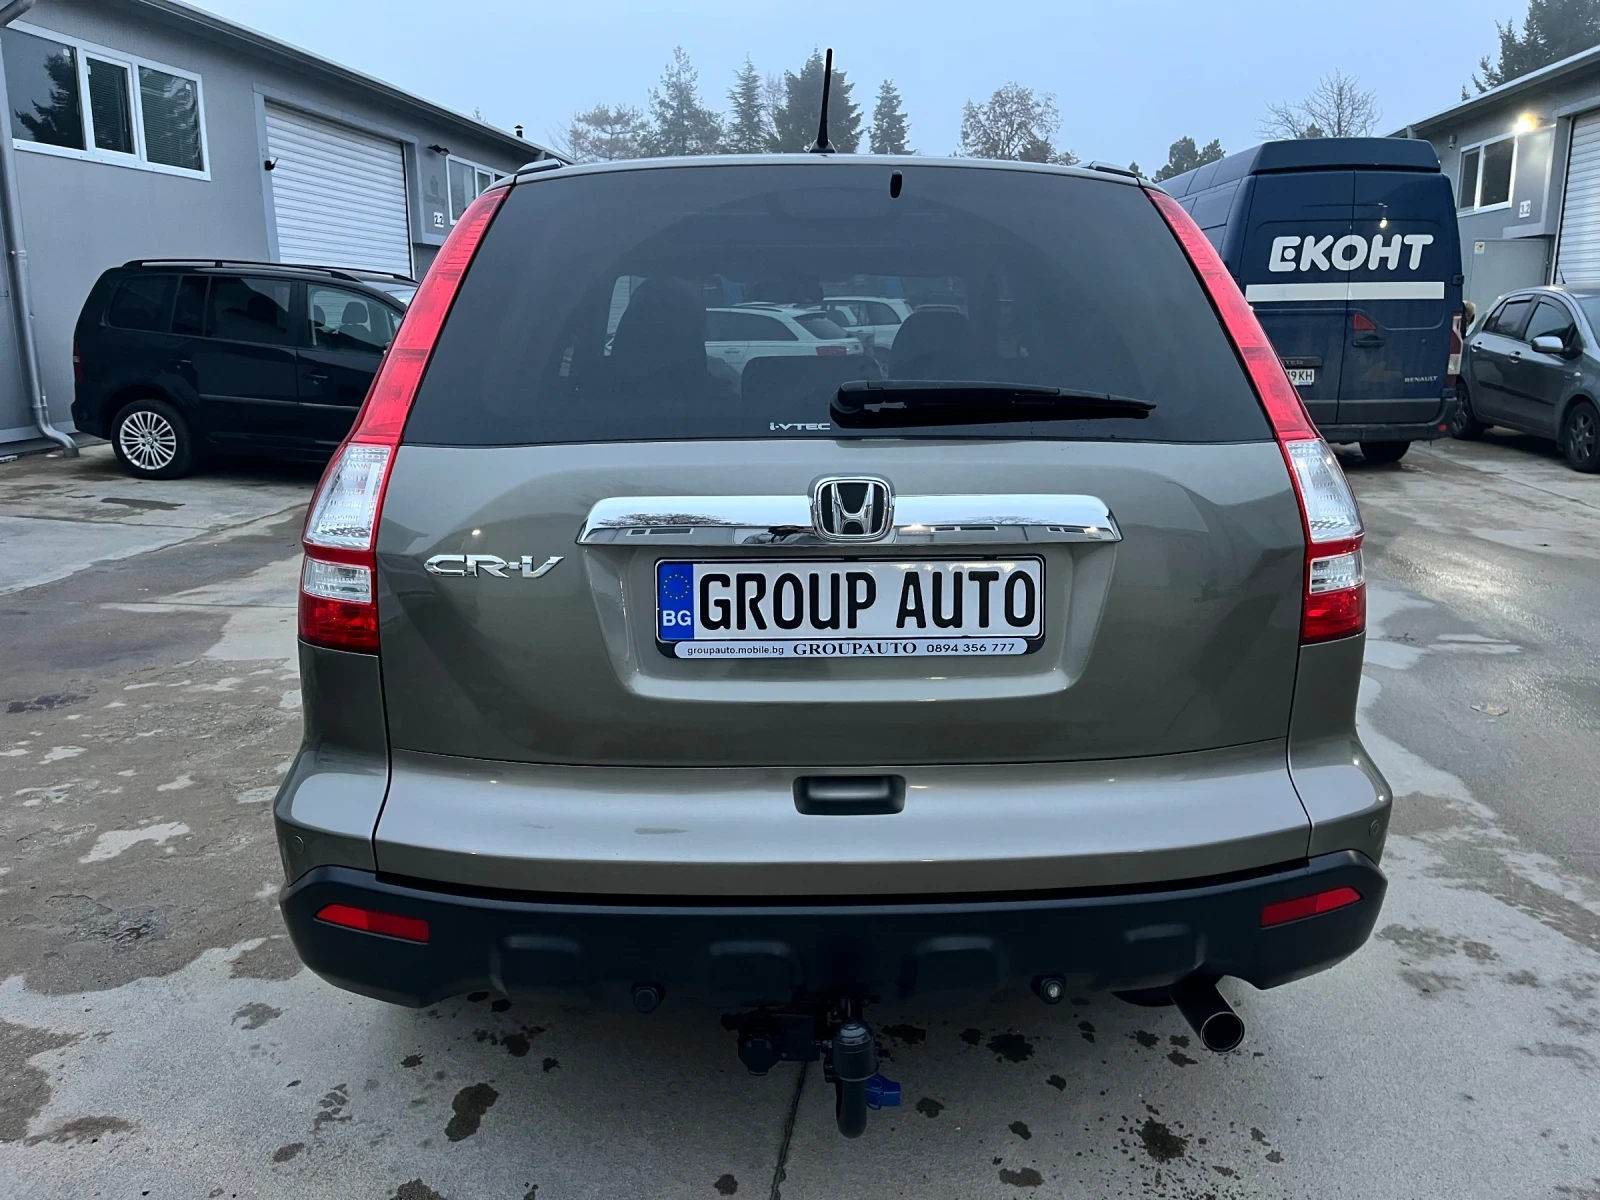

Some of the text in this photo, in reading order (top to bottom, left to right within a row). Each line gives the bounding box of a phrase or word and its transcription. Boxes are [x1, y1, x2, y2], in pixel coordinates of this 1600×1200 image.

[1268, 234, 1434, 272] ЕКОНТ
[1404, 375, 1438, 383] RENAULT
[423, 554, 565, 578] CR-V
[699, 569, 1036, 631] GROUP AUTO
[662, 609, 692, 627] BG
[687, 641, 1015, 656] groupauto.mobile.bg GROUPAUTO 0894 356 777
